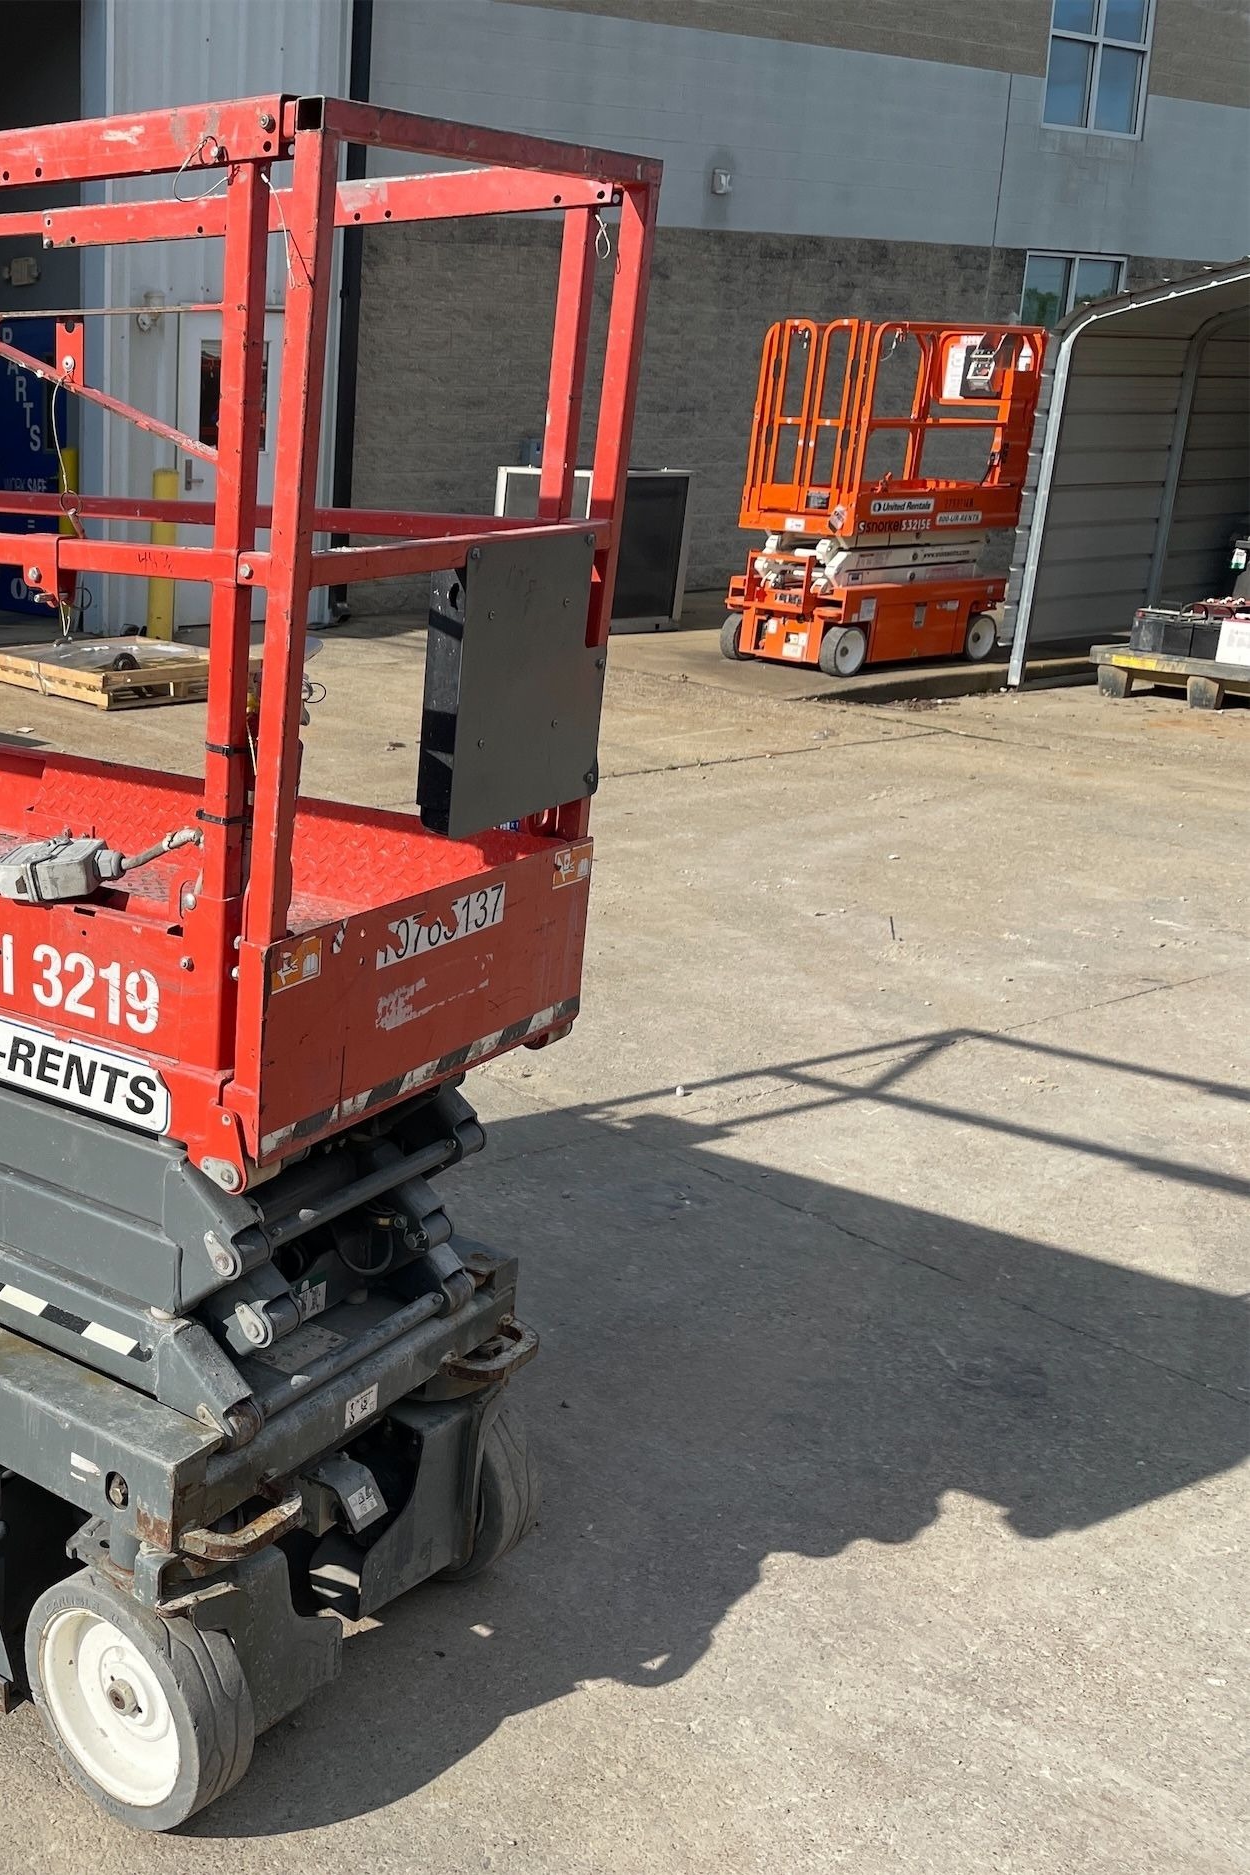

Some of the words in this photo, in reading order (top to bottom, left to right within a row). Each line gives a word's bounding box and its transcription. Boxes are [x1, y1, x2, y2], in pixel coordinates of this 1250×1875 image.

[882, 502, 905, 512] United
[906, 501, 932, 510] Rentals
[32, 944, 160, 1034] 3219
